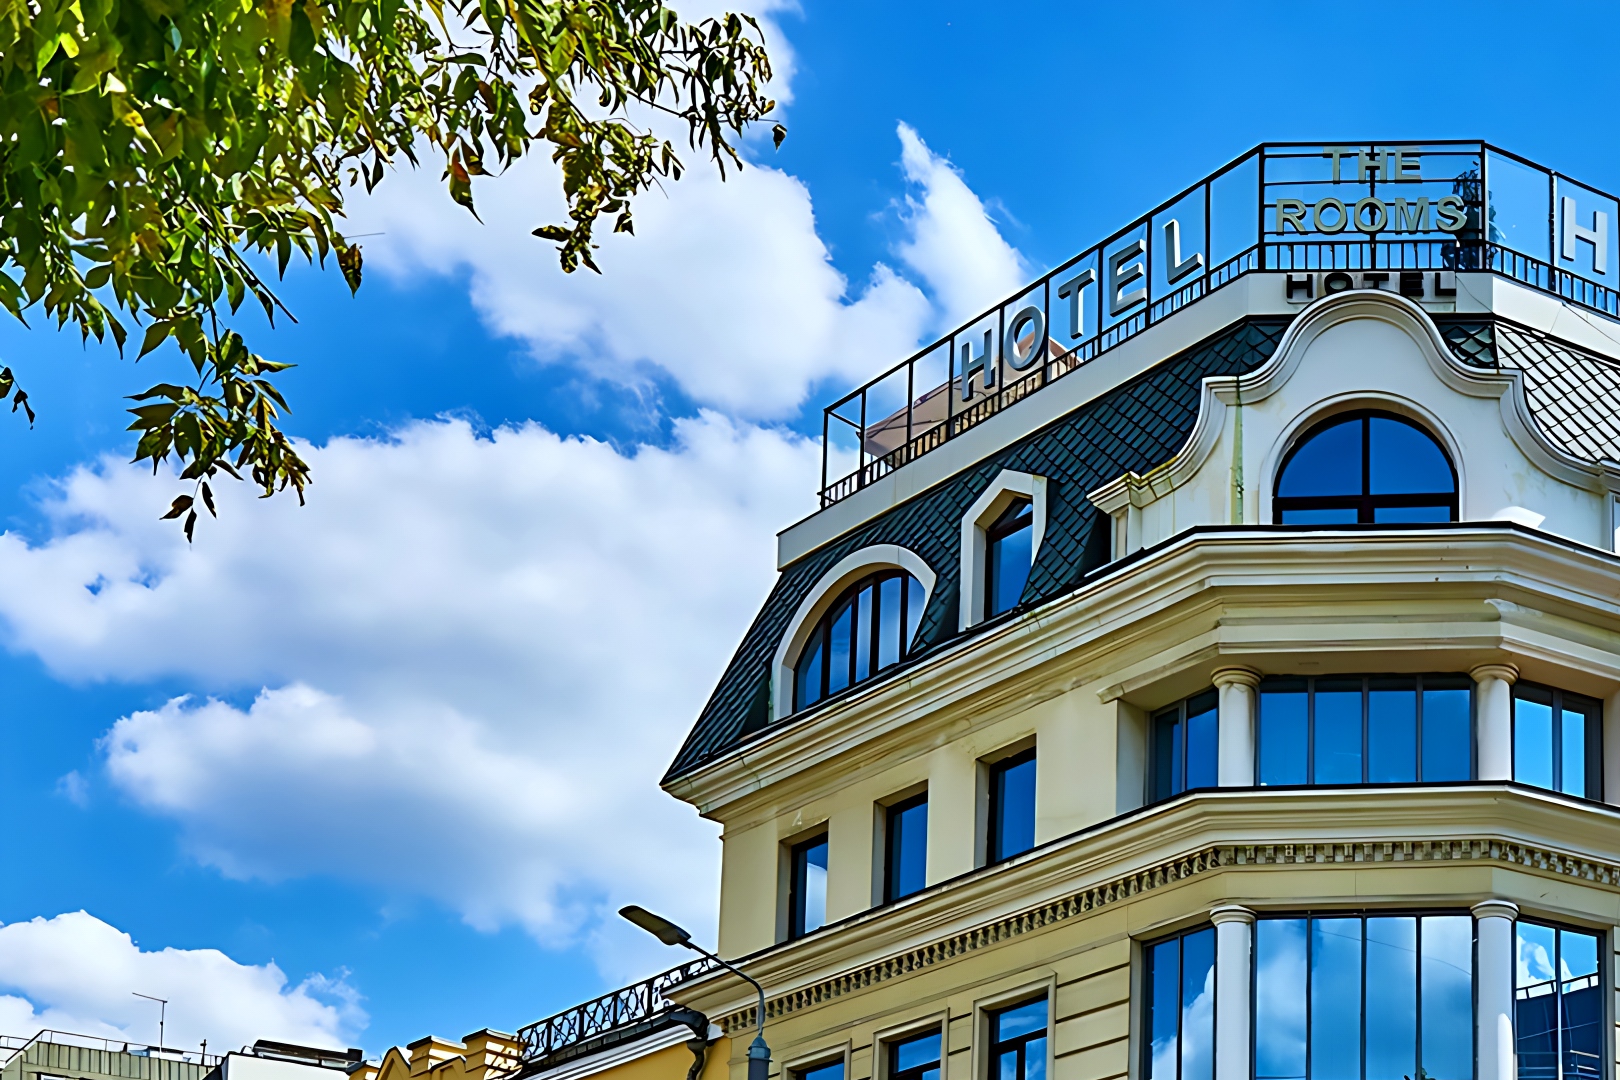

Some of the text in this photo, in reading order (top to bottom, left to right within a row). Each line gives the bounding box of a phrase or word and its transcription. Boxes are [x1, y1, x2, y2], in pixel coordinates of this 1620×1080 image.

[1323, 147, 1422, 184] THE
[1275, 195, 1468, 235] ROOMS
[1286, 272, 1457, 299] HOTEL
[960, 218, 1203, 400] HOTEL
